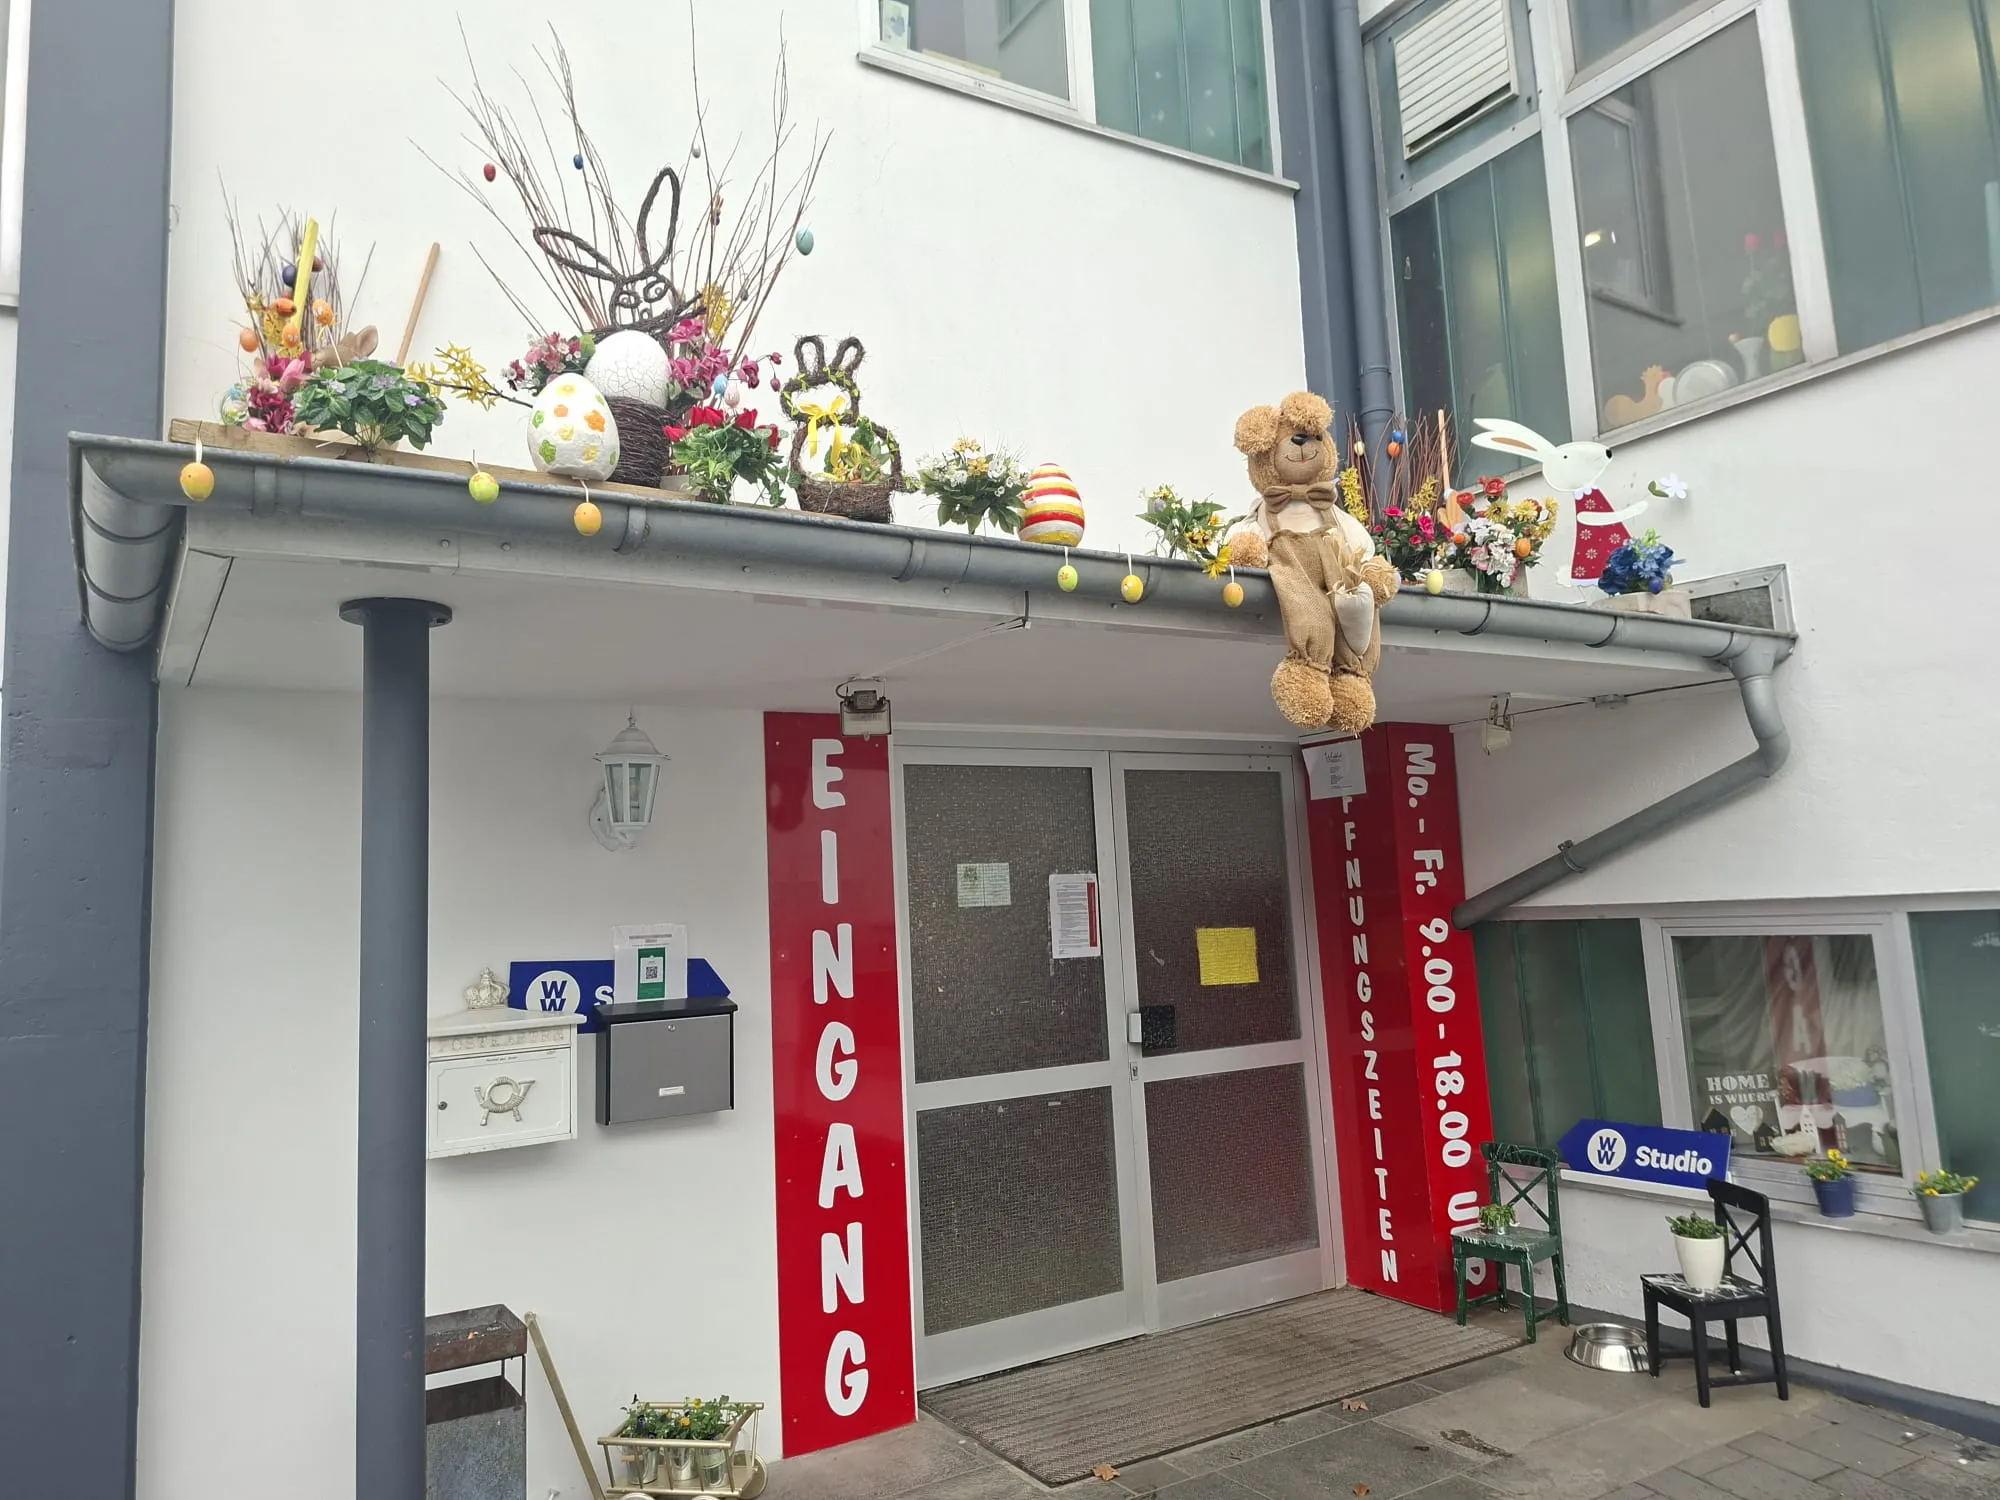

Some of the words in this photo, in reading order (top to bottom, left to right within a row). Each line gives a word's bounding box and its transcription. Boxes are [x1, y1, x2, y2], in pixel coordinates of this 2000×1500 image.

[1404, 743, 1436, 809] Mo.
[1413, 849, 1445, 896] Fr.
[594, 985, 614, 1006] S
[1341, 796, 1398, 1283] FFNUNGSZEITEN
[812, 738, 869, 1417] EINGANG
[1706, 1074, 1770, 1091] HOME
[1709, 1094, 1723, 1104] IS
[1635, 1145, 1712, 1175] Studio
